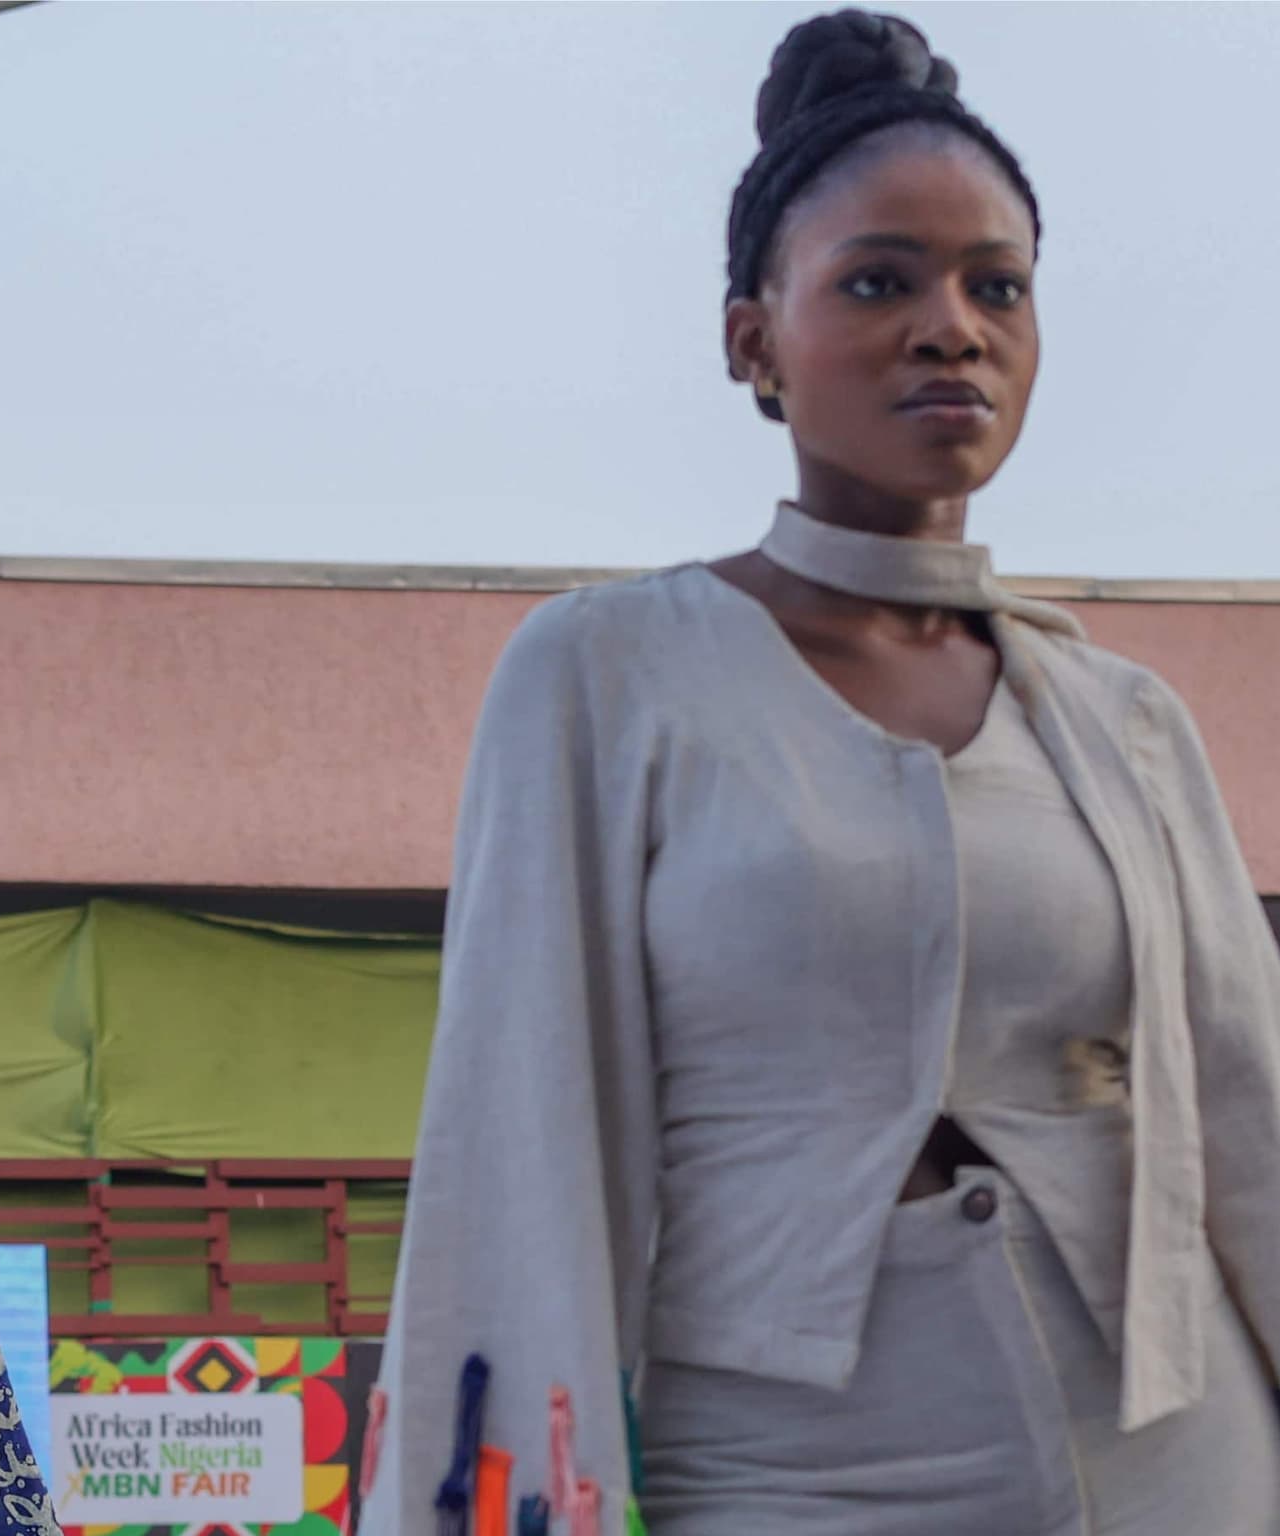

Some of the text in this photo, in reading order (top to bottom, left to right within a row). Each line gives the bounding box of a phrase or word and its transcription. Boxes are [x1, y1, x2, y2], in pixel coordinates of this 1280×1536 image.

[68, 1412, 263, 1438] Africa Fashion
[71, 1441, 263, 1475] Week Nigeria
[172, 1472, 251, 1497] FAIR
